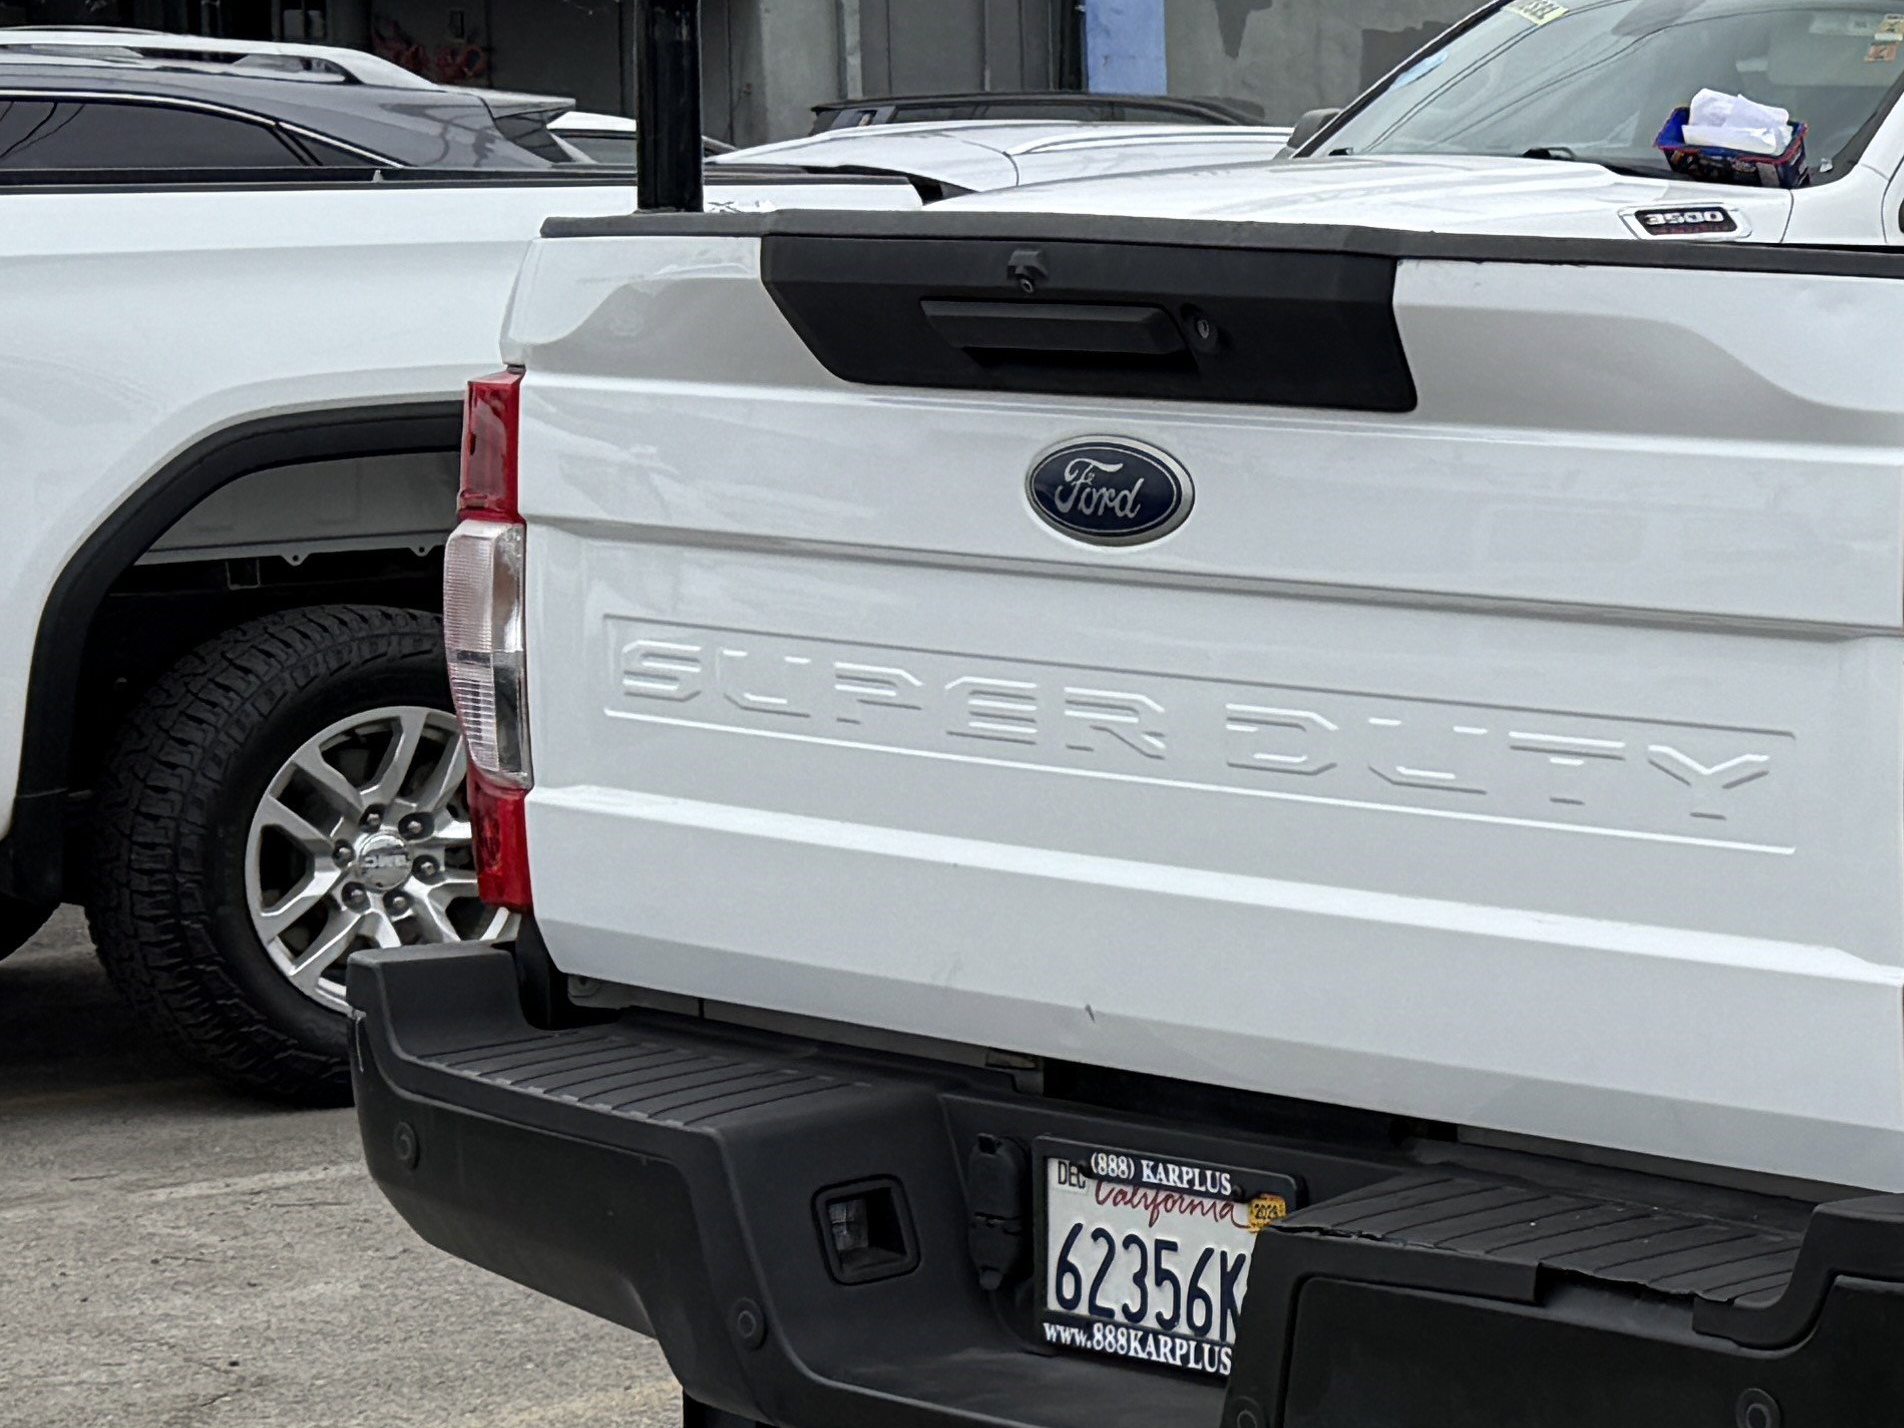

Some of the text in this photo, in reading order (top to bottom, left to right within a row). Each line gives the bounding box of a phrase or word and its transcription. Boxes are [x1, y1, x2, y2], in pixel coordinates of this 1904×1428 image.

[1643, 211, 1723, 225] 3500
[1054, 458, 1144, 518] Ford
[618, 638, 1771, 820] SUPER DUTY
[1058, 1160, 1086, 1189] DEC
[1091, 1152, 1232, 1195] (888) KARPLUS
[1095, 1180, 1250, 1228] California
